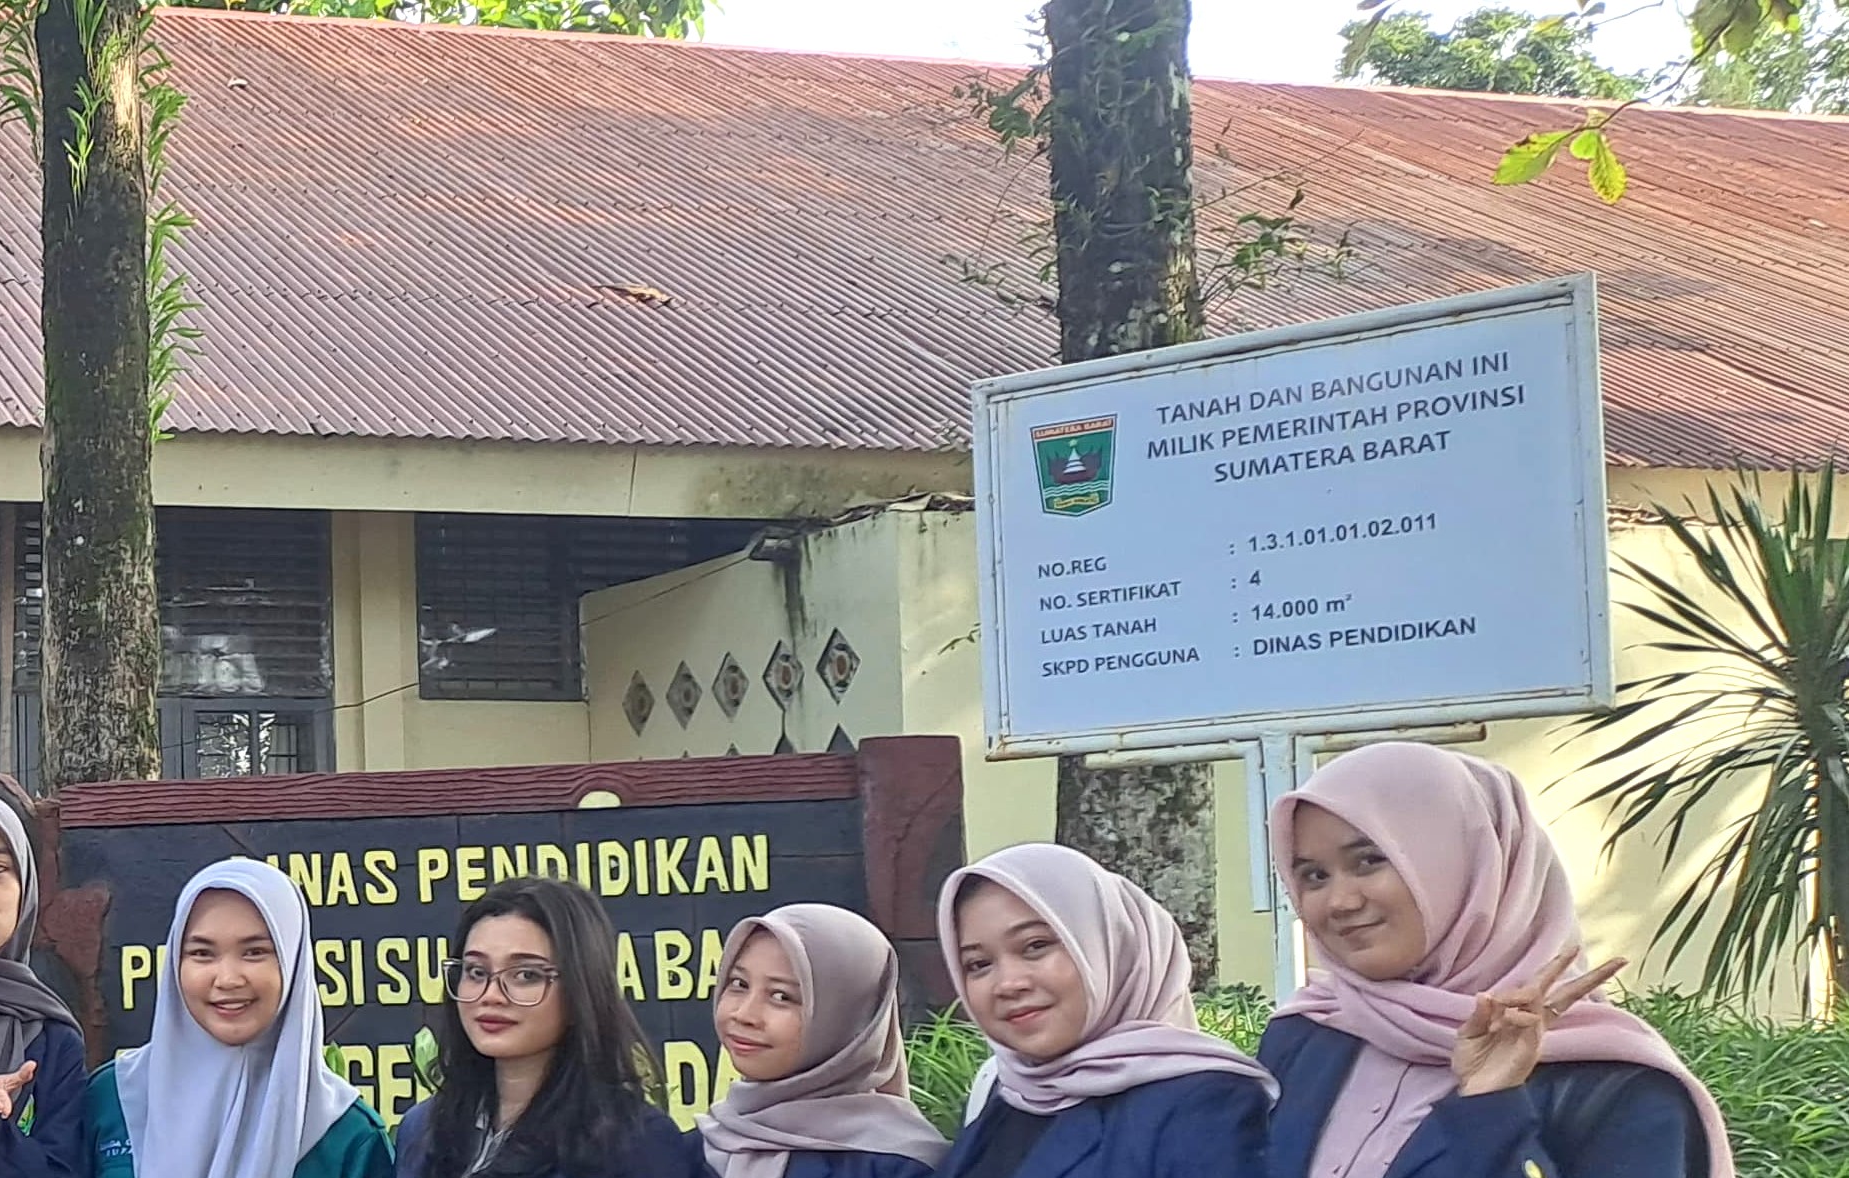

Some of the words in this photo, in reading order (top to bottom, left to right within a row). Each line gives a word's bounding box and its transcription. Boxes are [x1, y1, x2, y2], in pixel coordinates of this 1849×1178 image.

[1156, 395, 1241, 425] TANAH
[1249, 385, 1302, 411] DAN
[1311, 359, 1463, 401] BANGUNAN
[1472, 351, 1509, 376] INI
[1147, 432, 1215, 459] MILIK
[1222, 405, 1388, 448] PEMERINTAH
[1397, 384, 1525, 422] PROVINSI
[1214, 445, 1356, 483] SUMATERA
[1363, 430, 1452, 461] BARAT
[1038, 556, 1107, 579] NO.REG
[1248, 513, 1437, 552] 1.3.1.01.01.02.011
[1040, 595, 1072, 611] NO.
[1077, 580, 1182, 607] SERTIFIKAT
[1249, 570, 1262, 586] 4
[1041, 625, 1088, 645] LUAS
[1092, 617, 1157, 638] TANAH
[1251, 598, 1319, 621] 14.000
[1041, 658, 1090, 678] SKPD
[1095, 647, 1200, 672] PENGGUNA
[1253, 632, 1322, 656] DINAS
[1329, 616, 1477, 648] PENDIDIKAN
[230, 850, 399, 906] NAS
[417, 834, 770, 903] PENDIDIKAN
